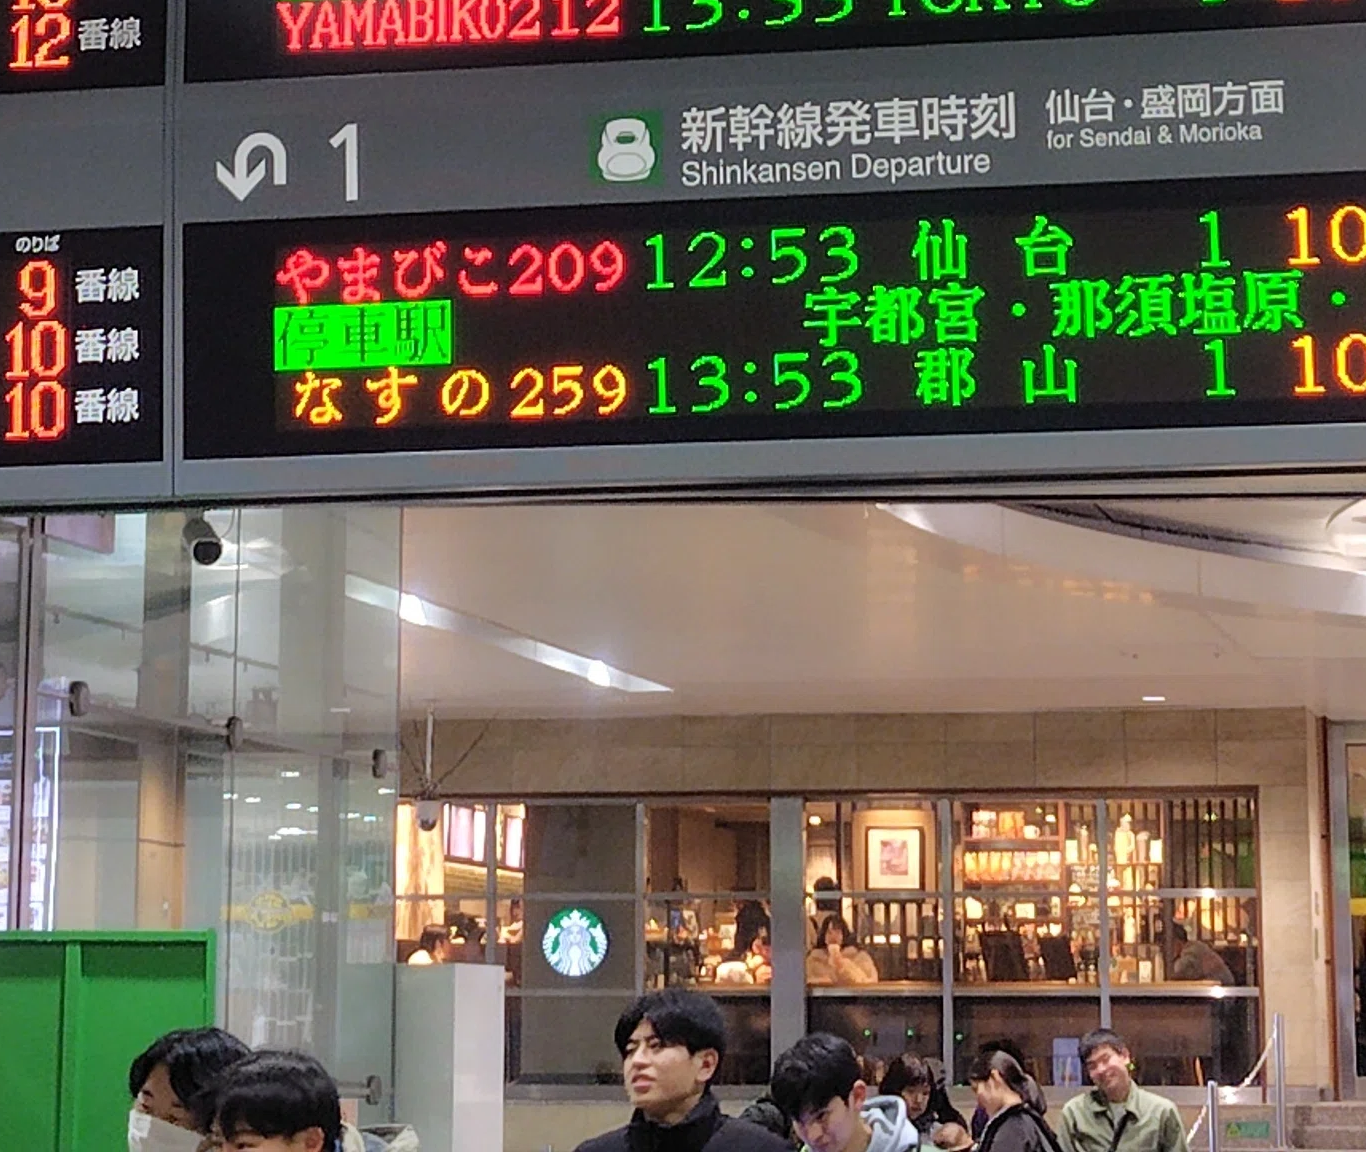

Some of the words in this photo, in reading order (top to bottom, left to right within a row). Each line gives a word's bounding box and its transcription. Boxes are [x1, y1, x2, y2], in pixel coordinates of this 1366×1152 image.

[8, 12, 73, 71] 12
[681, 91, 1017, 153] 新幹線発車時刻
[1046, 78, 1285, 126] 仙台・盛岡方面
[328, 122, 360, 202] 1
[1046, 129, 1073, 150] for
[1079, 126, 1150, 149] Sendai
[1157, 126, 1173, 146] &
[1179, 121, 1263, 145] Morioka
[681, 154, 841, 188] Shinkansen
[851, 147, 991, 184] Departure
[15, 233, 61, 254] のりば
[645, 224, 861, 291] 12:53
[1199, 210, 1231, 267] 1
[17, 259, 58, 320] 9
[75, 268, 140, 304] 番線
[5, 319, 68, 382] 10
[75, 327, 140, 363] 番線
[278, 304, 447, 366] 停車駅
[5, 379, 68, 442] 10
[75, 387, 140, 424] 番線
[648, 350, 864, 415] 13:53
[1204, 344, 1237, 399] 1
